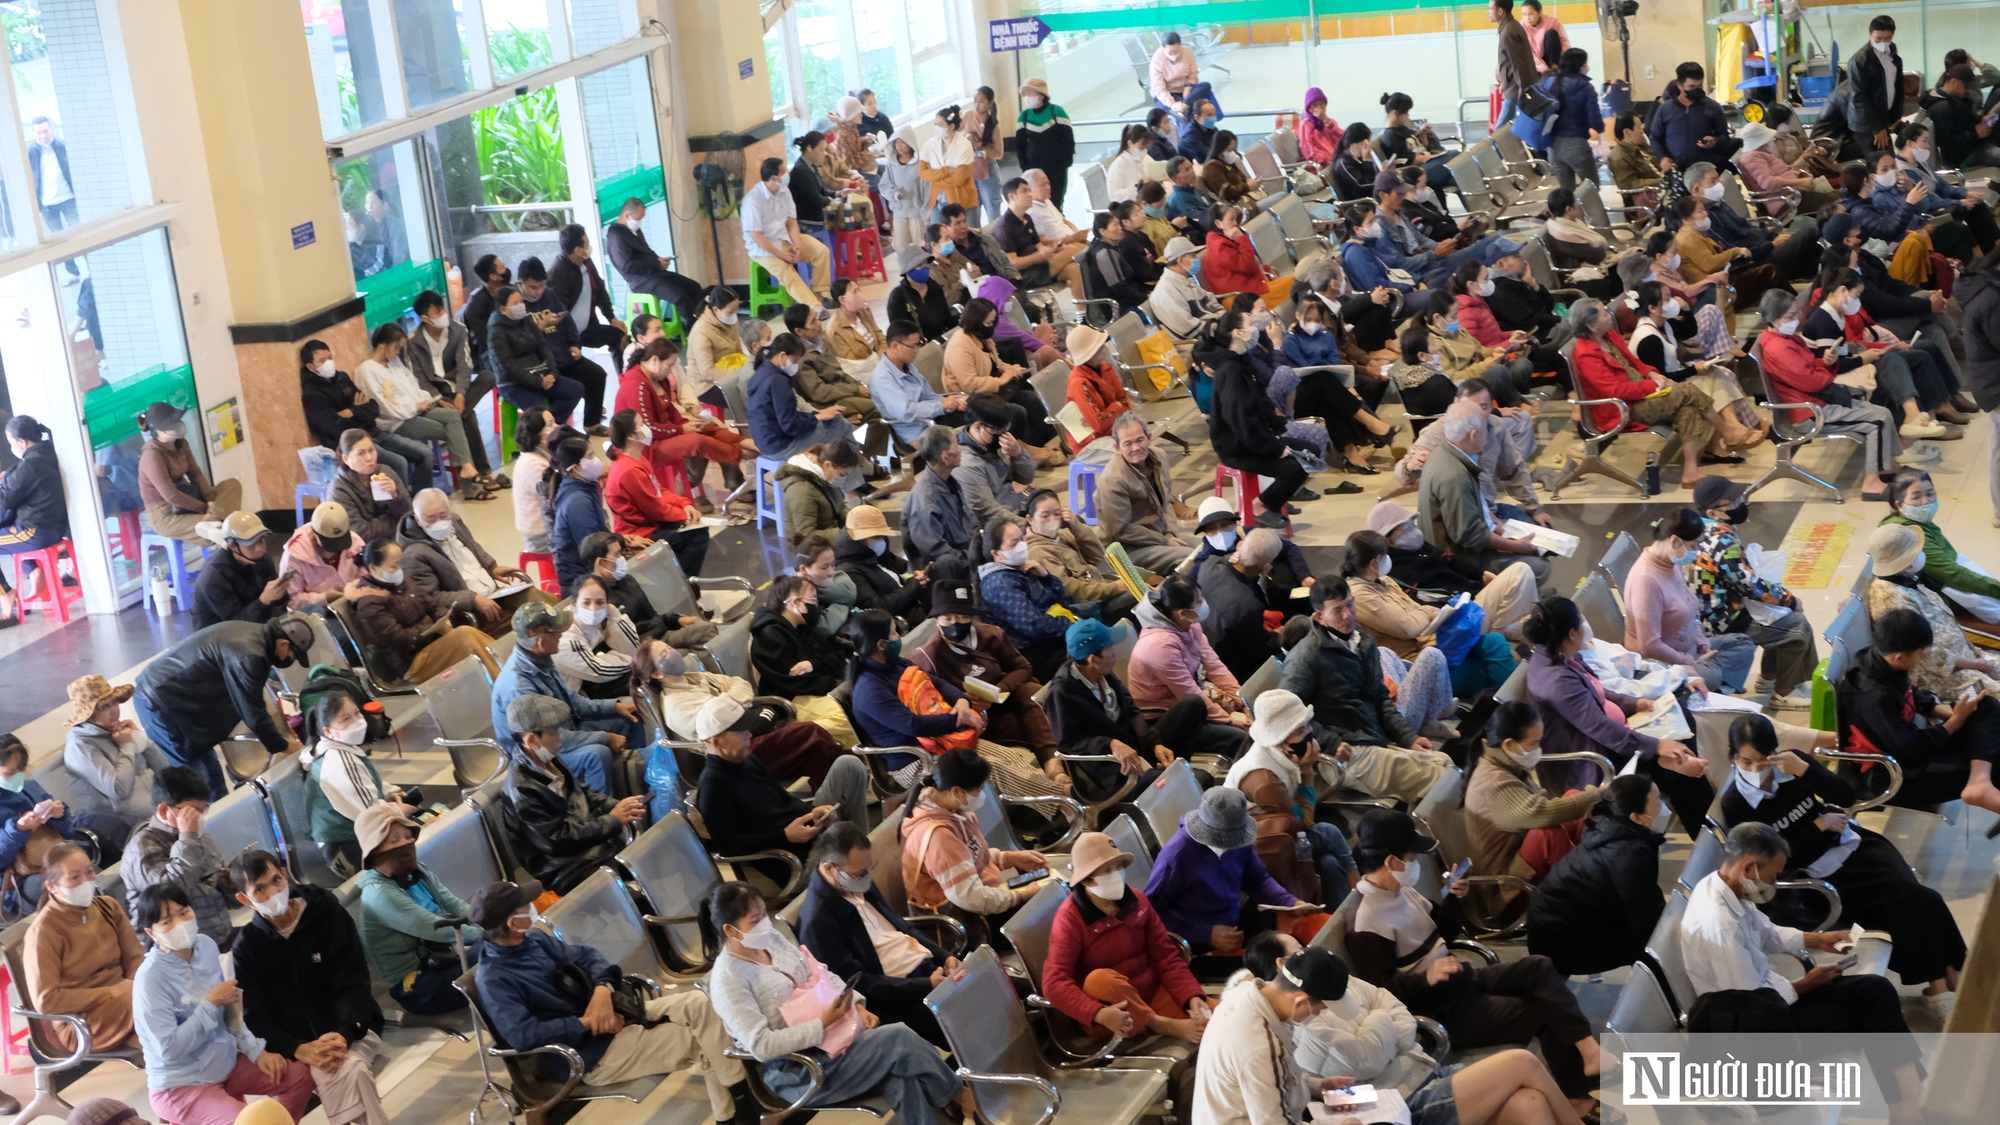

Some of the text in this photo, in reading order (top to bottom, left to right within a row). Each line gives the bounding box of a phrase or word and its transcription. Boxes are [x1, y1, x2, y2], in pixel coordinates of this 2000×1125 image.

[991, 18, 1039, 36] NHÀ THUỐC
[993, 33, 1038, 50] BỆNH VIỆN
